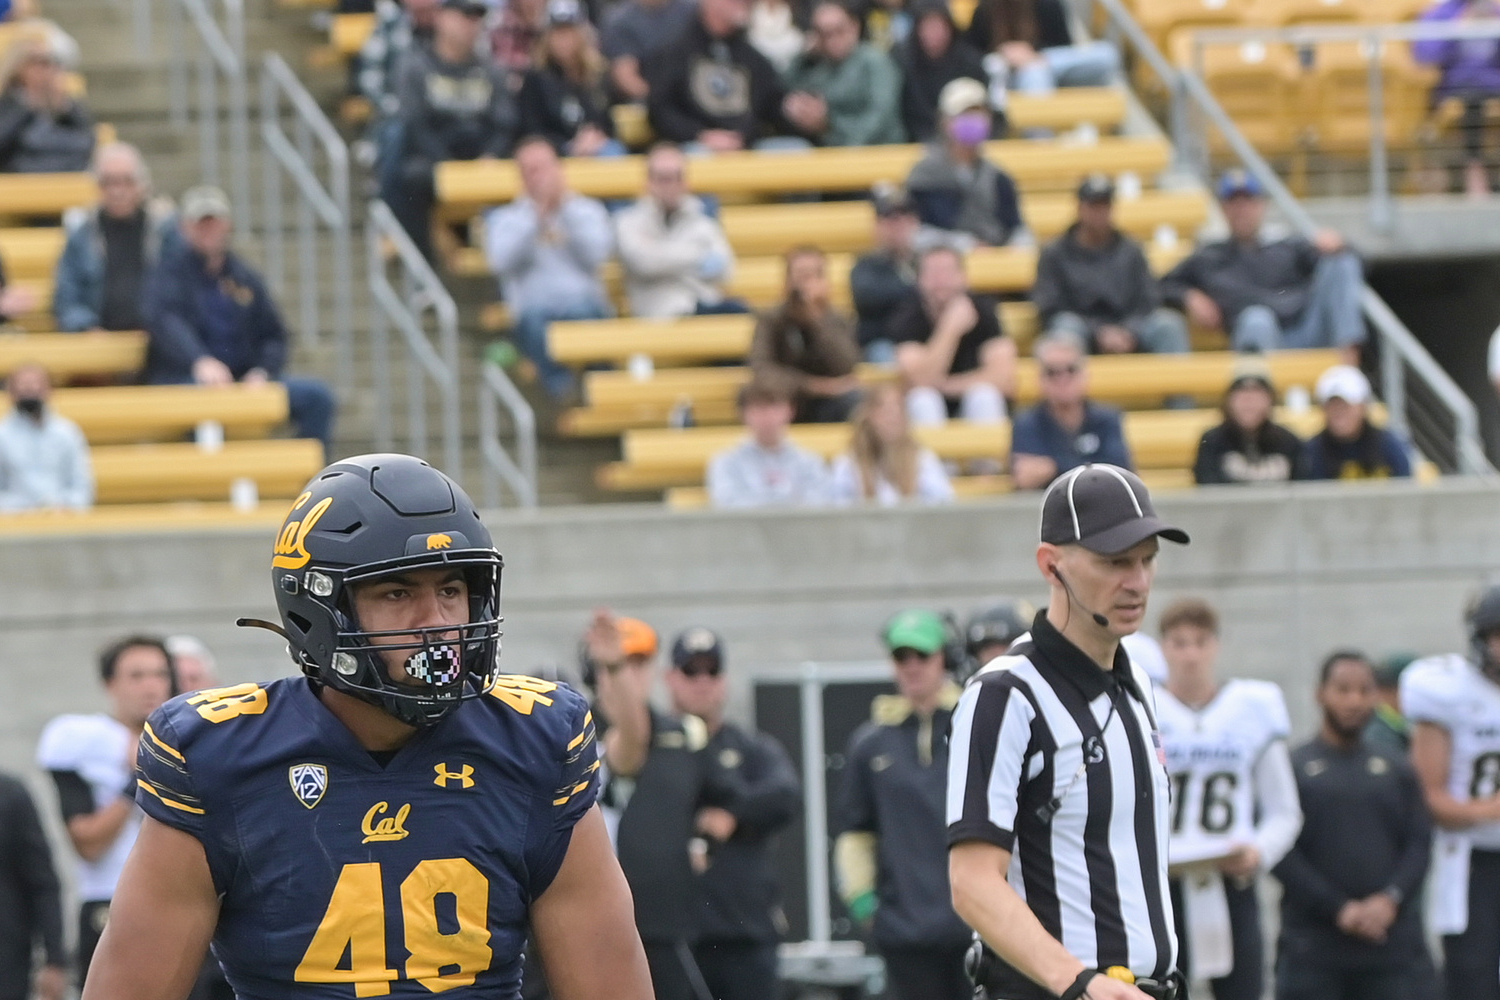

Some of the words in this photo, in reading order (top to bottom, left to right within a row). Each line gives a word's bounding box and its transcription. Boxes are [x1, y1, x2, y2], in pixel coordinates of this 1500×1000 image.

[300, 782, 319, 799] 12
[1171, 770, 1237, 834] 16
[361, 801, 411, 844] Cal
[294, 857, 493, 998] 48
